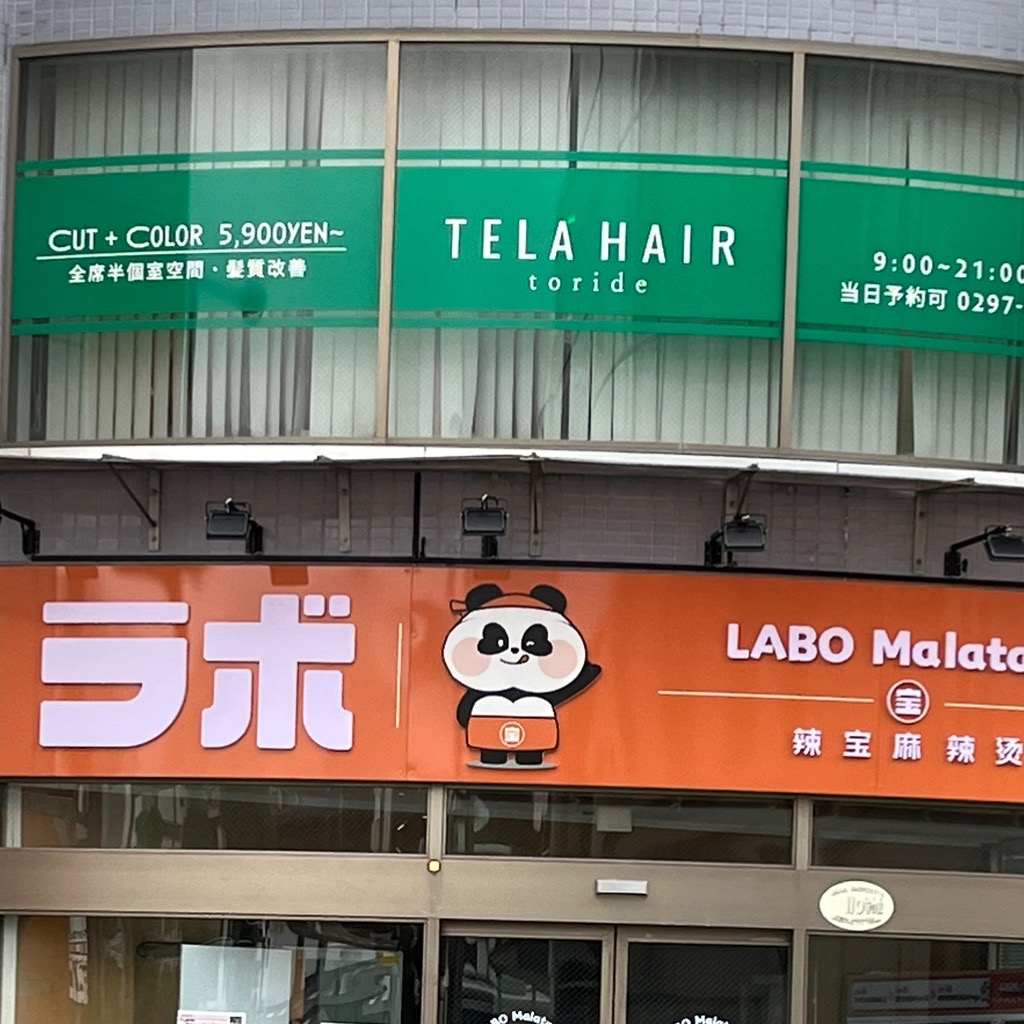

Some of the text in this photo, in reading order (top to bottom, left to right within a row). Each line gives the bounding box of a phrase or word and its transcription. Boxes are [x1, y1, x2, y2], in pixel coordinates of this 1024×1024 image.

[48, 228, 98, 252] CUT
[126, 223, 203, 249] COLOR
[444, 218, 736, 266] TELA HAIR
[528, 271, 648, 294] toride
[840, 281, 948, 311] 当日予約可
[727, 623, 854, 664] LABO
[39, 594, 356, 751] ラボ
